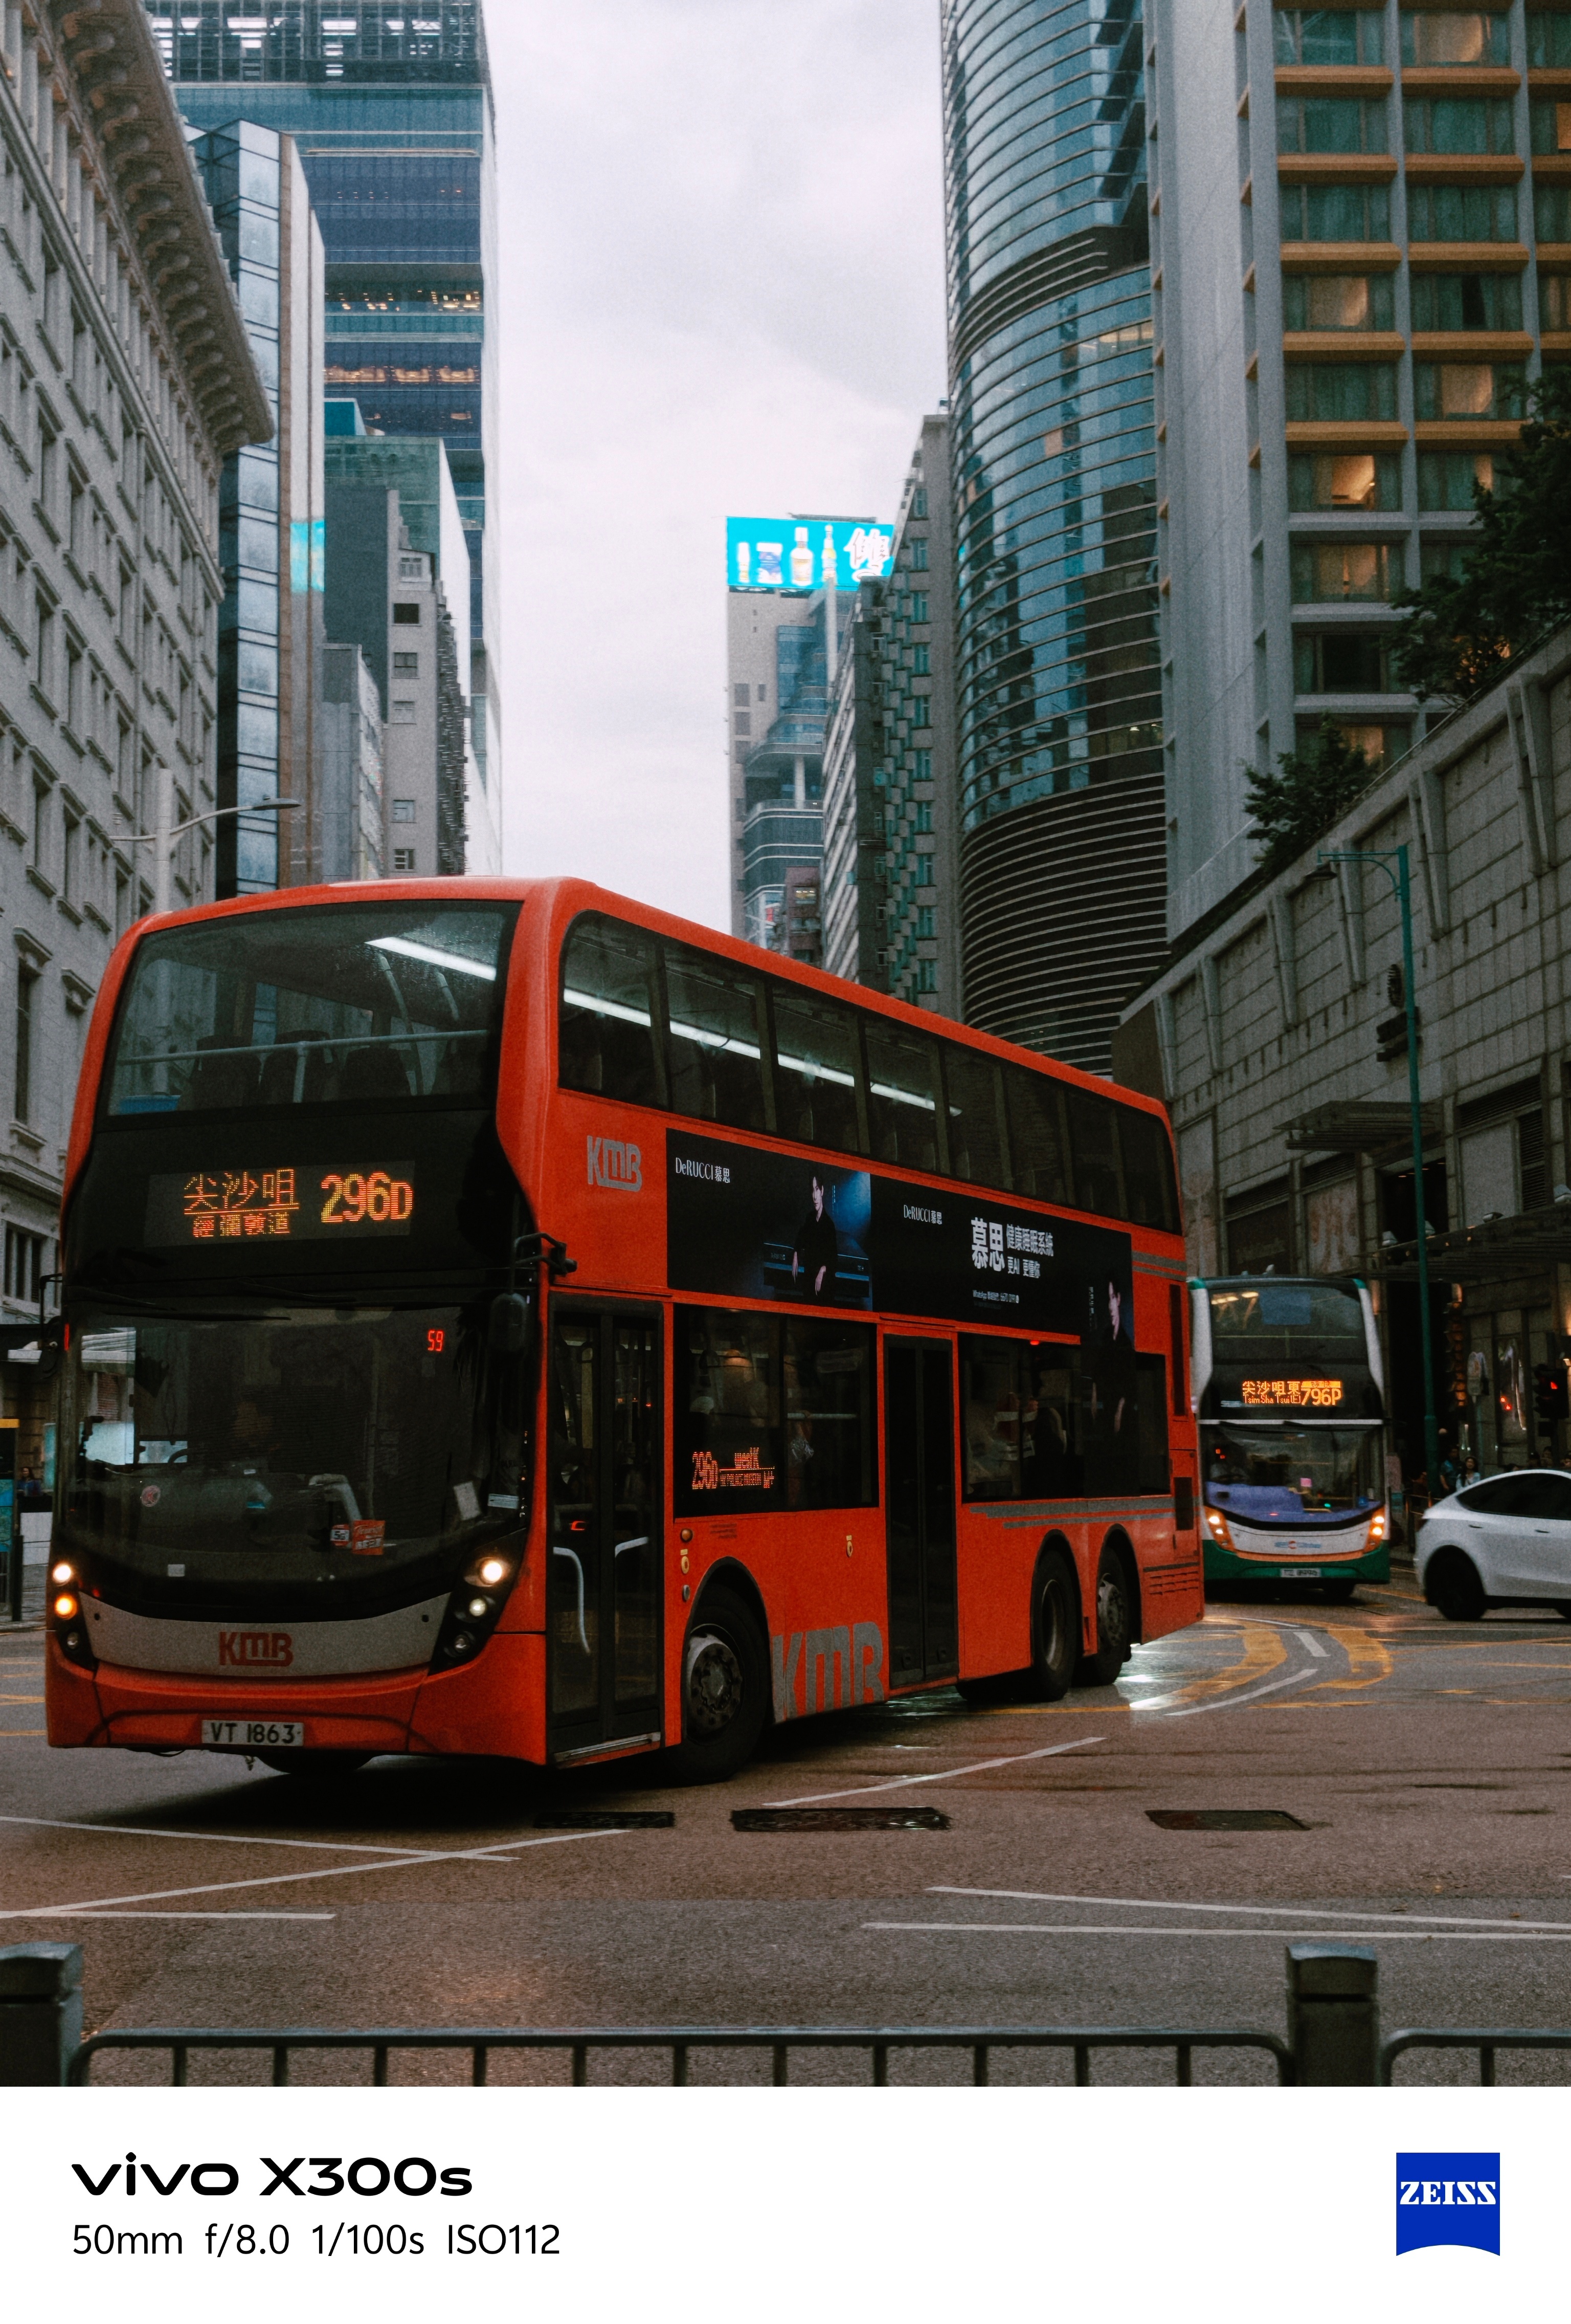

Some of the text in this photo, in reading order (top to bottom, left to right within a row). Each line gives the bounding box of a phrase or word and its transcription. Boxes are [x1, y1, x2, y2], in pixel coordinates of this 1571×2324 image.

[587, 1135, 642, 1192] KMB
[676, 1157, 730, 1183] DeRUCCI 慕思
[184, 1169, 300, 1210] 尖沙咀
[321, 1171, 413, 1223] 296D
[904, 1204, 930, 1223] DeRUCCI
[971, 1217, 1005, 1272] 慕思
[428, 1329, 444, 1352] 59
[1243, 1381, 1300, 1395] 尖沙咀東
[1243, 1394, 1260, 1404] Tsim
[1261, 1394, 1274, 1404] Sha
[1301, 1388, 1341, 1405] 796P
[692, 1451, 719, 1490] 296D
[219, 1632, 294, 1667] KMB
[771, 1622, 884, 1724] KMB
[210, 1722, 295, 1744] VT 1863
